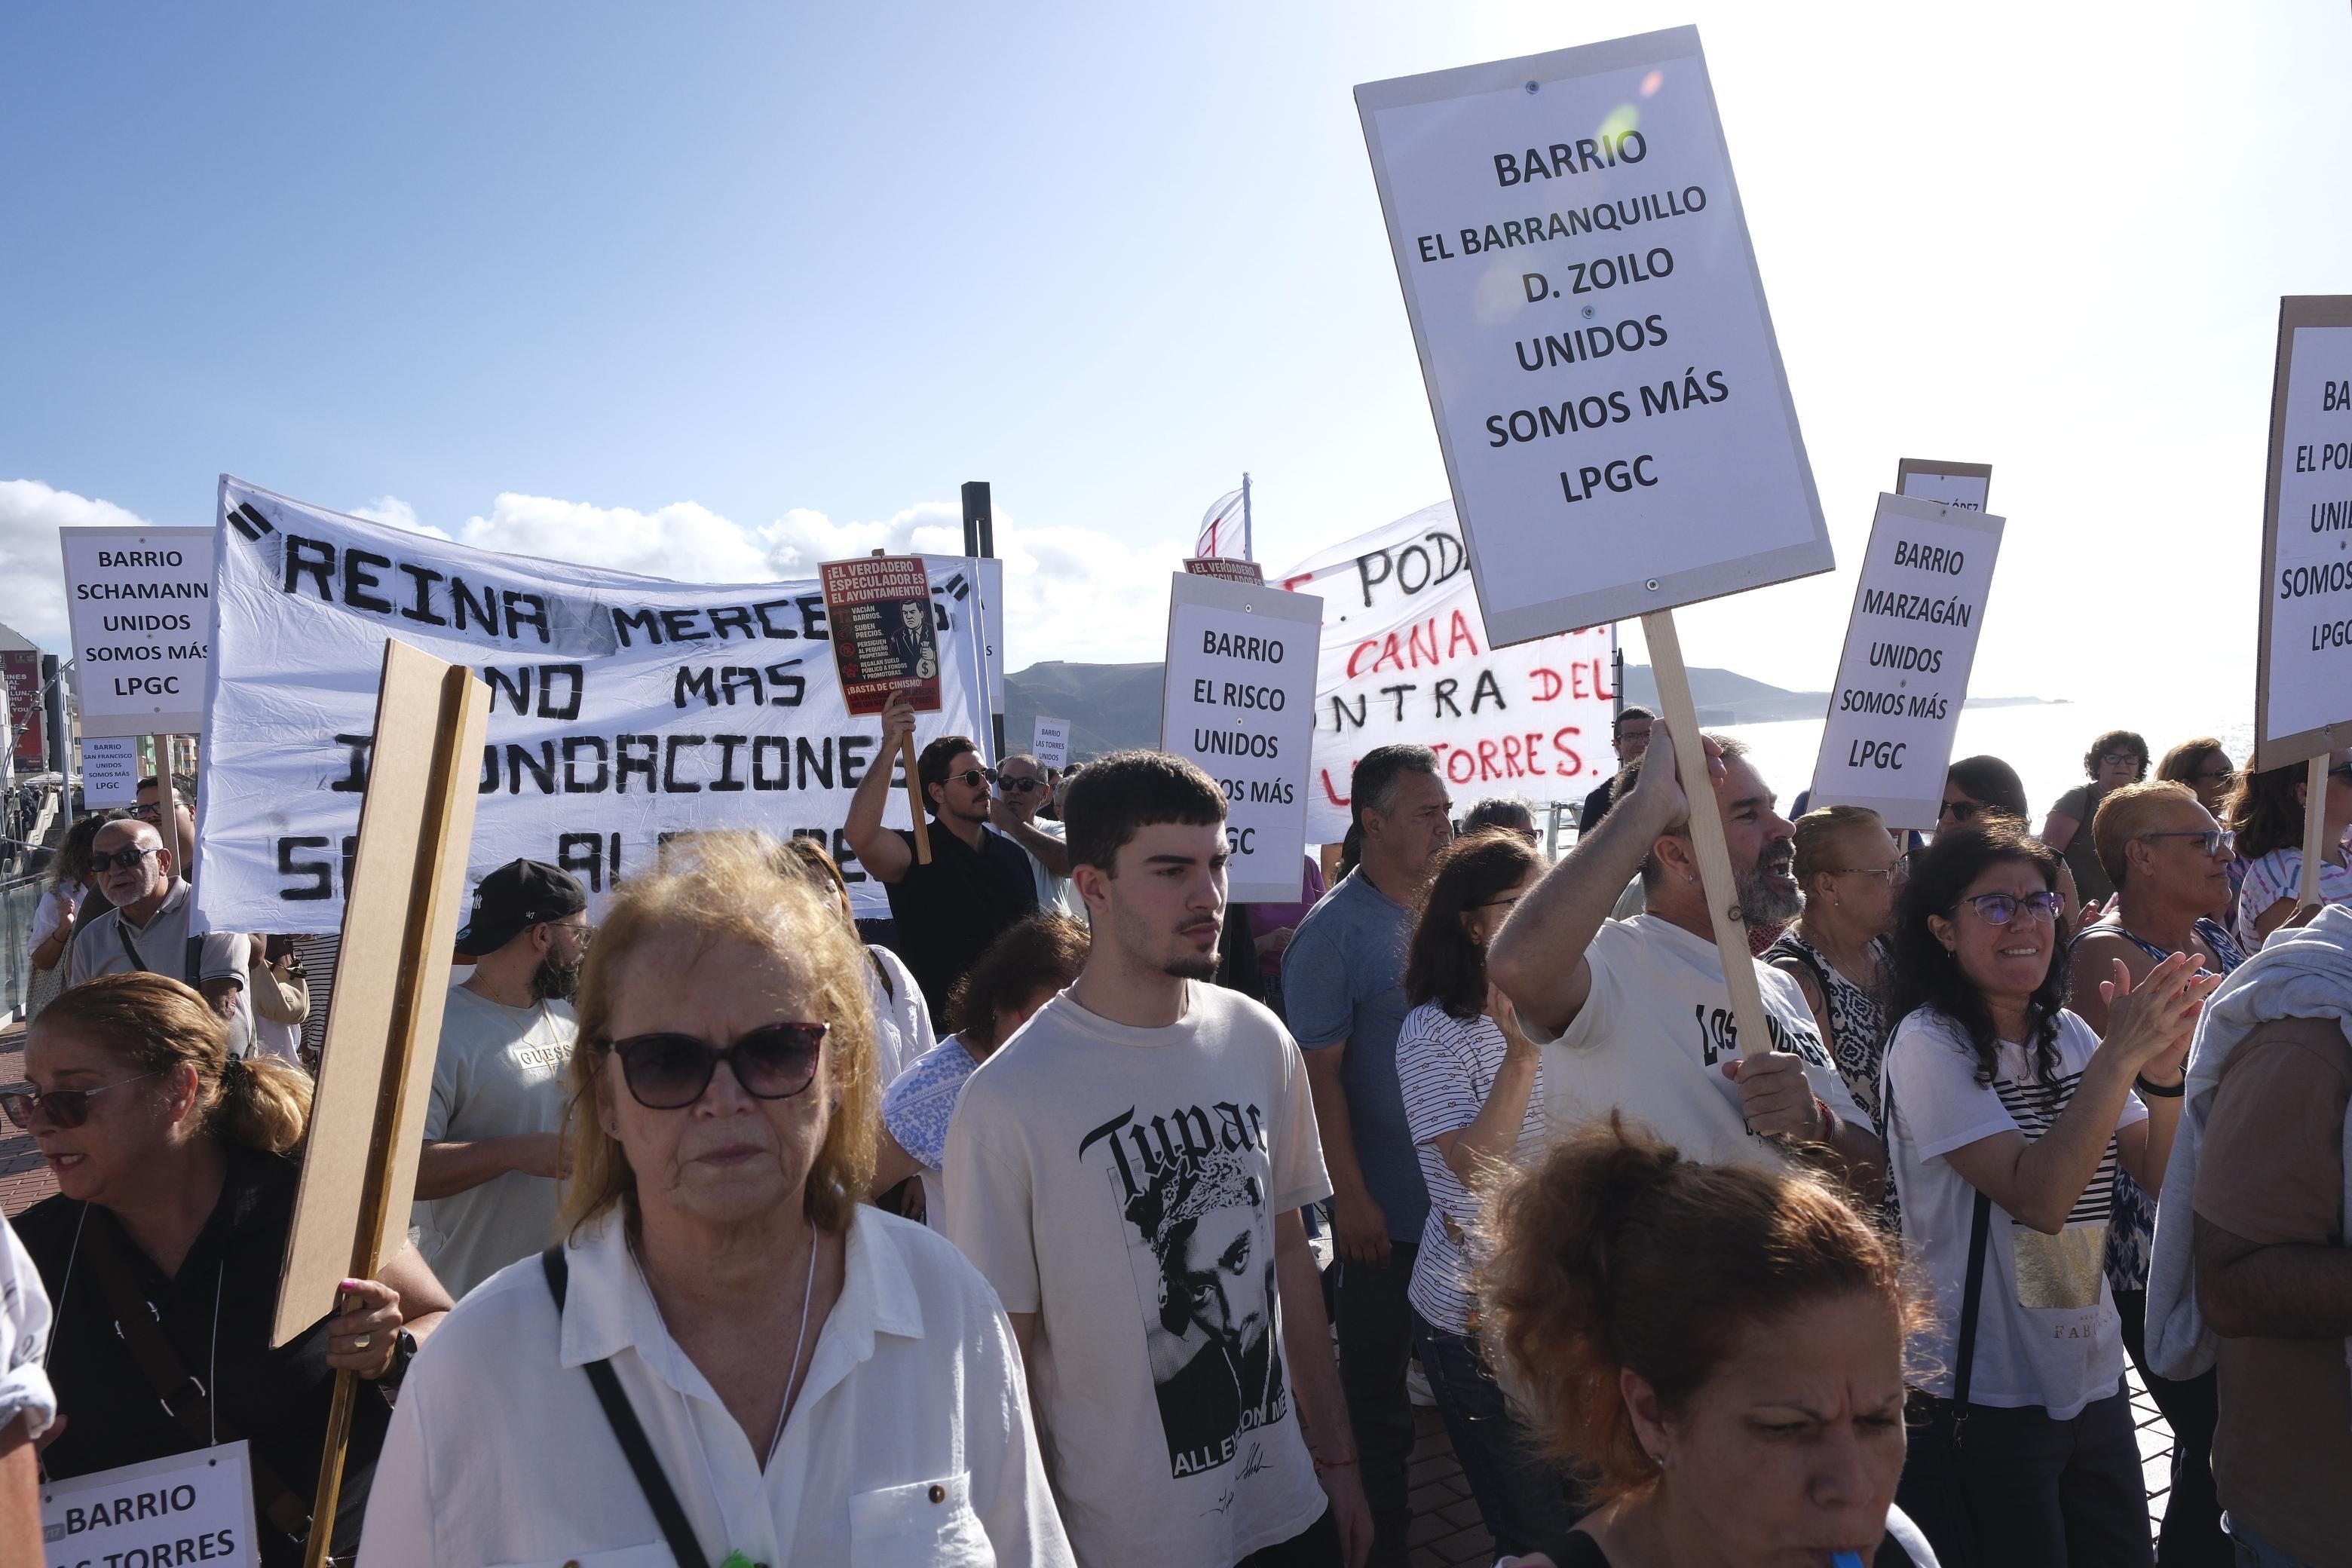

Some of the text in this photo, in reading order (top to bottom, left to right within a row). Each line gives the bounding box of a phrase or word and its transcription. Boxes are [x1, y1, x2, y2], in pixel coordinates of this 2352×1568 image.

[1493, 130, 1647, 187] BARRIO
[1417, 185, 1707, 262] EL BARRANQUILLO
[1522, 247, 1674, 303] D. ZOILO
[1514, 314, 1668, 372] UNIDOS
[1486, 366, 1729, 448] SOMOS MÁS
[2323, 380, 2351, 411] BA
[2296, 442, 2352, 473] EL PO
[1559, 454, 1658, 504] LPGC
[98, 550, 183, 567] BARRIO
[828, 561, 914, 580] ¡EL VERDADERO
[1192, 562, 1254, 577] ¡EL VERDADERO
[1357, 531, 1470, 608] POD
[1894, 541, 1965, 576] BARRIO
[77, 583, 209, 600] SCHAMANN
[830, 573, 924, 592] ESPECULADOR ES
[831, 586, 924, 603] EL AYUNTAMIENTO!
[853, 612, 882, 622] BARRIOS.
[1862, 589, 1971, 628] MARZAGÁN
[103, 614, 191, 631] UNIDOS
[854, 623, 875, 632] SUBEN
[856, 629, 884, 639] PRECIOS.
[86, 646, 162, 661] SOMOS
[857, 639, 887, 648] PERSIGUEN
[859, 651, 890, 660] PROPIETARIO.
[865, 645, 888, 653] PEQUEÑO
[1203, 630, 1284, 664] BARRIO
[860, 660, 883, 668] REGALAN
[861, 665, 883, 674] PÚBLICO
[1870, 642, 1943, 674] UNIDOS
[115, 676, 179, 696] LPGC
[675, 659, 806, 709] MAS
[847, 678, 923, 695] ¡BASTA DE CINISMO!
[867, 669, 902, 679] PROMOTORAS.
[1194, 678, 1285, 712] EL RISCO
[1313, 658, 1613, 733] NTRA DEL
[1841, 689, 1948, 721] SOMOS MÁS
[1041, 728, 1061, 737] BARRIO
[1046, 741, 1064, 750] TORRES
[1194, 728, 1278, 759] UNIDOS
[1039, 753, 1058, 761] UNIDOS
[1848, 739, 1906, 770] LPGC
[1250, 777, 1294, 804] MÁS
[1225, 826, 1255, 856] GC
[1174, 1445, 1219, 1476] ALL
[66, 1484, 196, 1535] BARRIO
